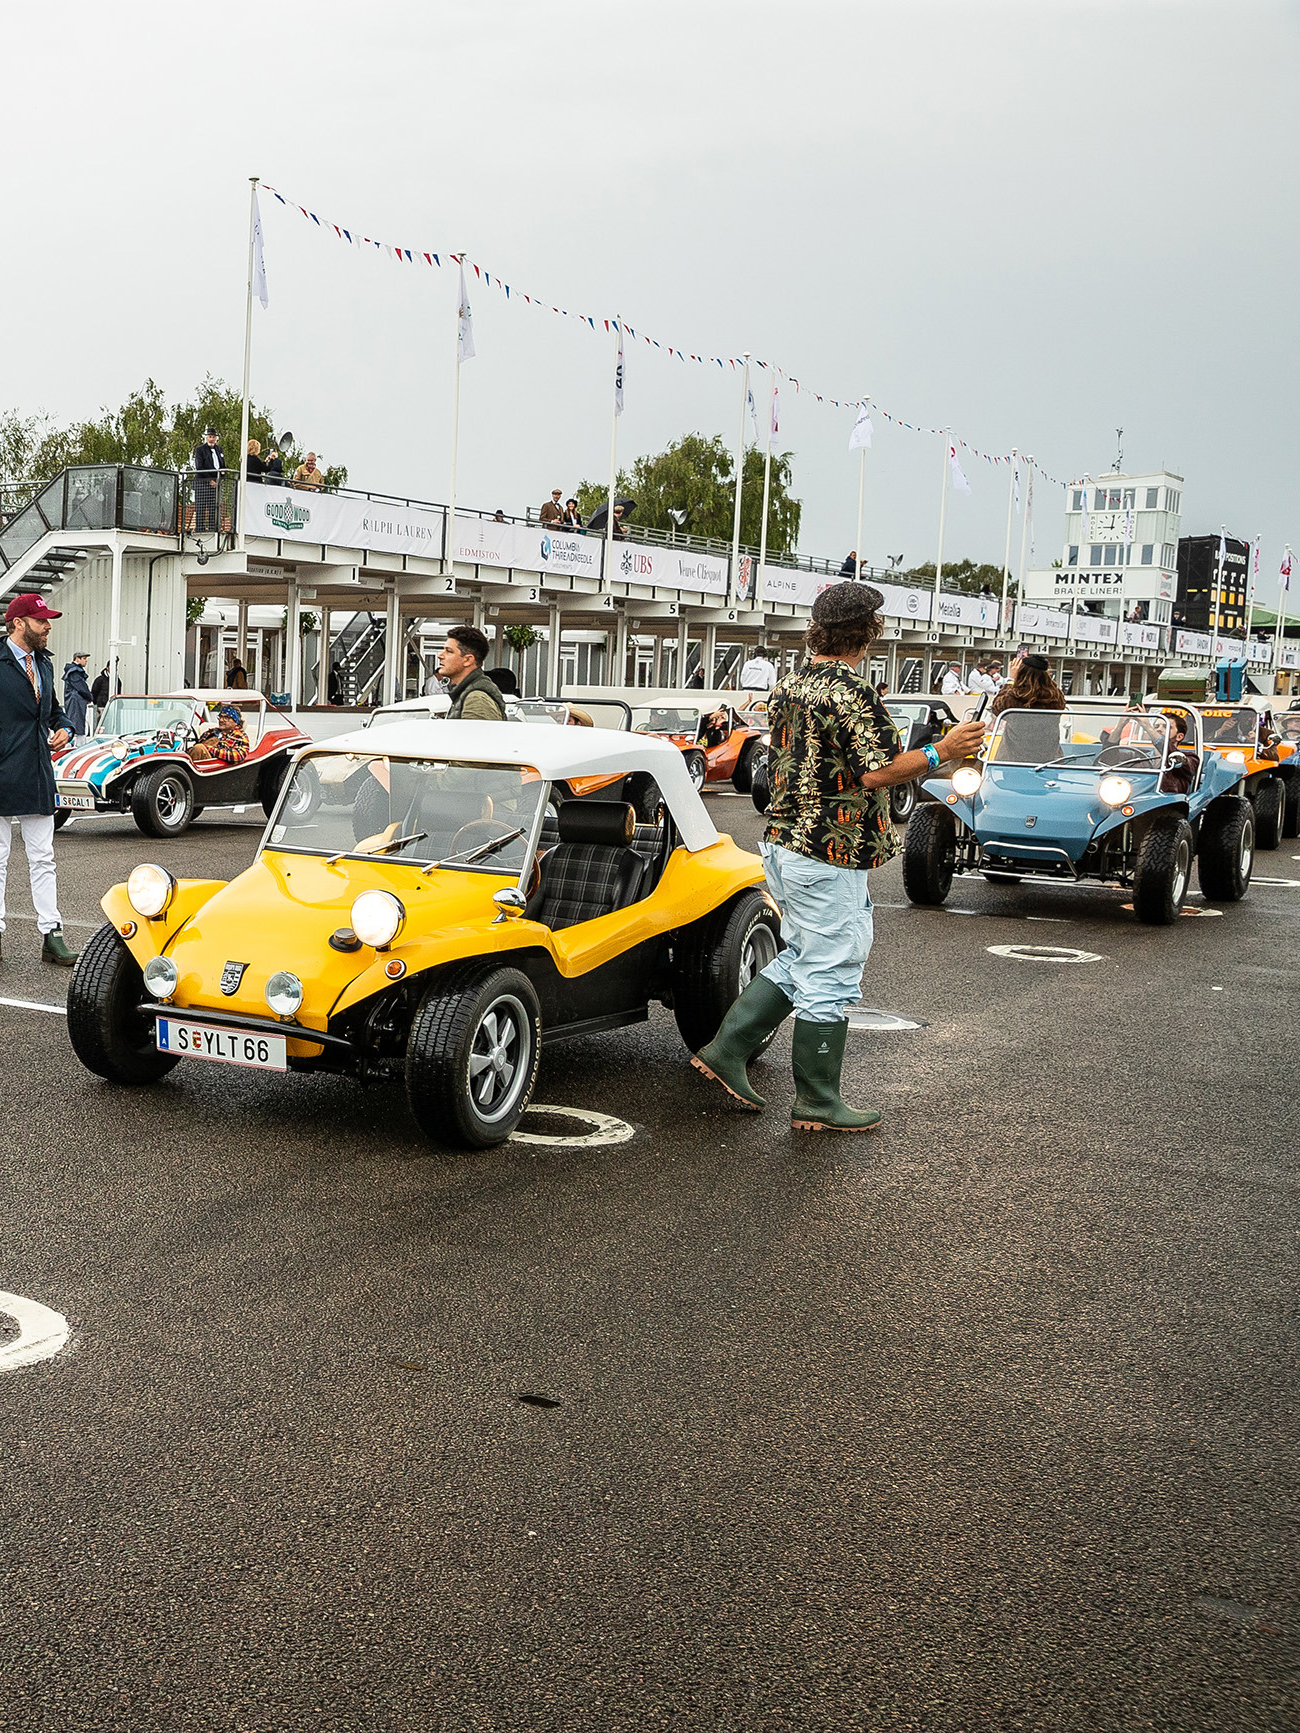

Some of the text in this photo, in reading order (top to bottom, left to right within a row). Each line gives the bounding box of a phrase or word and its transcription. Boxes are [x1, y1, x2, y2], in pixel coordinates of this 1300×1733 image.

[362, 518, 433, 540] RALPH LAUREN
[459, 547, 501, 560] EDMISTON
[552, 550, 593, 565] THREADNEEDLE
[633, 553, 653, 575] UBS
[678, 559, 696, 578] Veuve
[1055, 573, 1123, 584] MINTEX
[445, 578, 453, 591] 2
[766, 580, 797, 591] ALPINE
[529, 588, 537, 600] 3
[603, 596, 611, 607] 4
[669, 604, 676, 614] 5
[728, 609, 735, 620] 6
[894, 629, 900, 638] 9
[926, 633, 938, 641] 10
[963, 636, 972, 645] 11
[994, 640, 1004, 648] 12
[62, 797, 90, 807] S CAL 1
[762, 908, 773, 918] T/A
[161, 1027, 269, 1062] A S YLT 66
